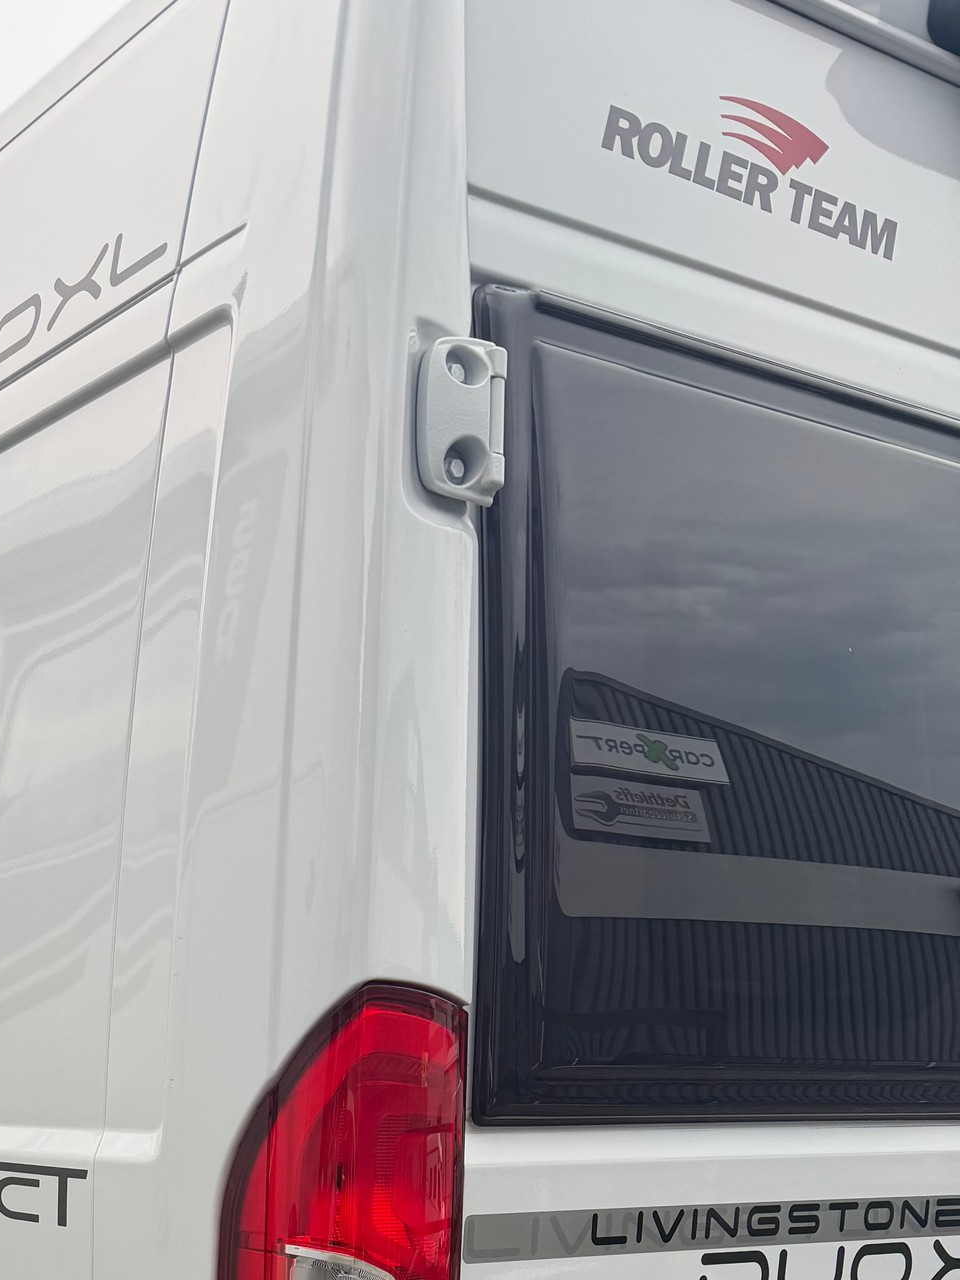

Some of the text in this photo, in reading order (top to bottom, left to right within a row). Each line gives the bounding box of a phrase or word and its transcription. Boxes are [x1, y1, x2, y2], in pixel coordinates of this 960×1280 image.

[601, 104, 898, 261] ROLLER TEAM
[591, 1197, 960, 1246] LIVINGSTONE
